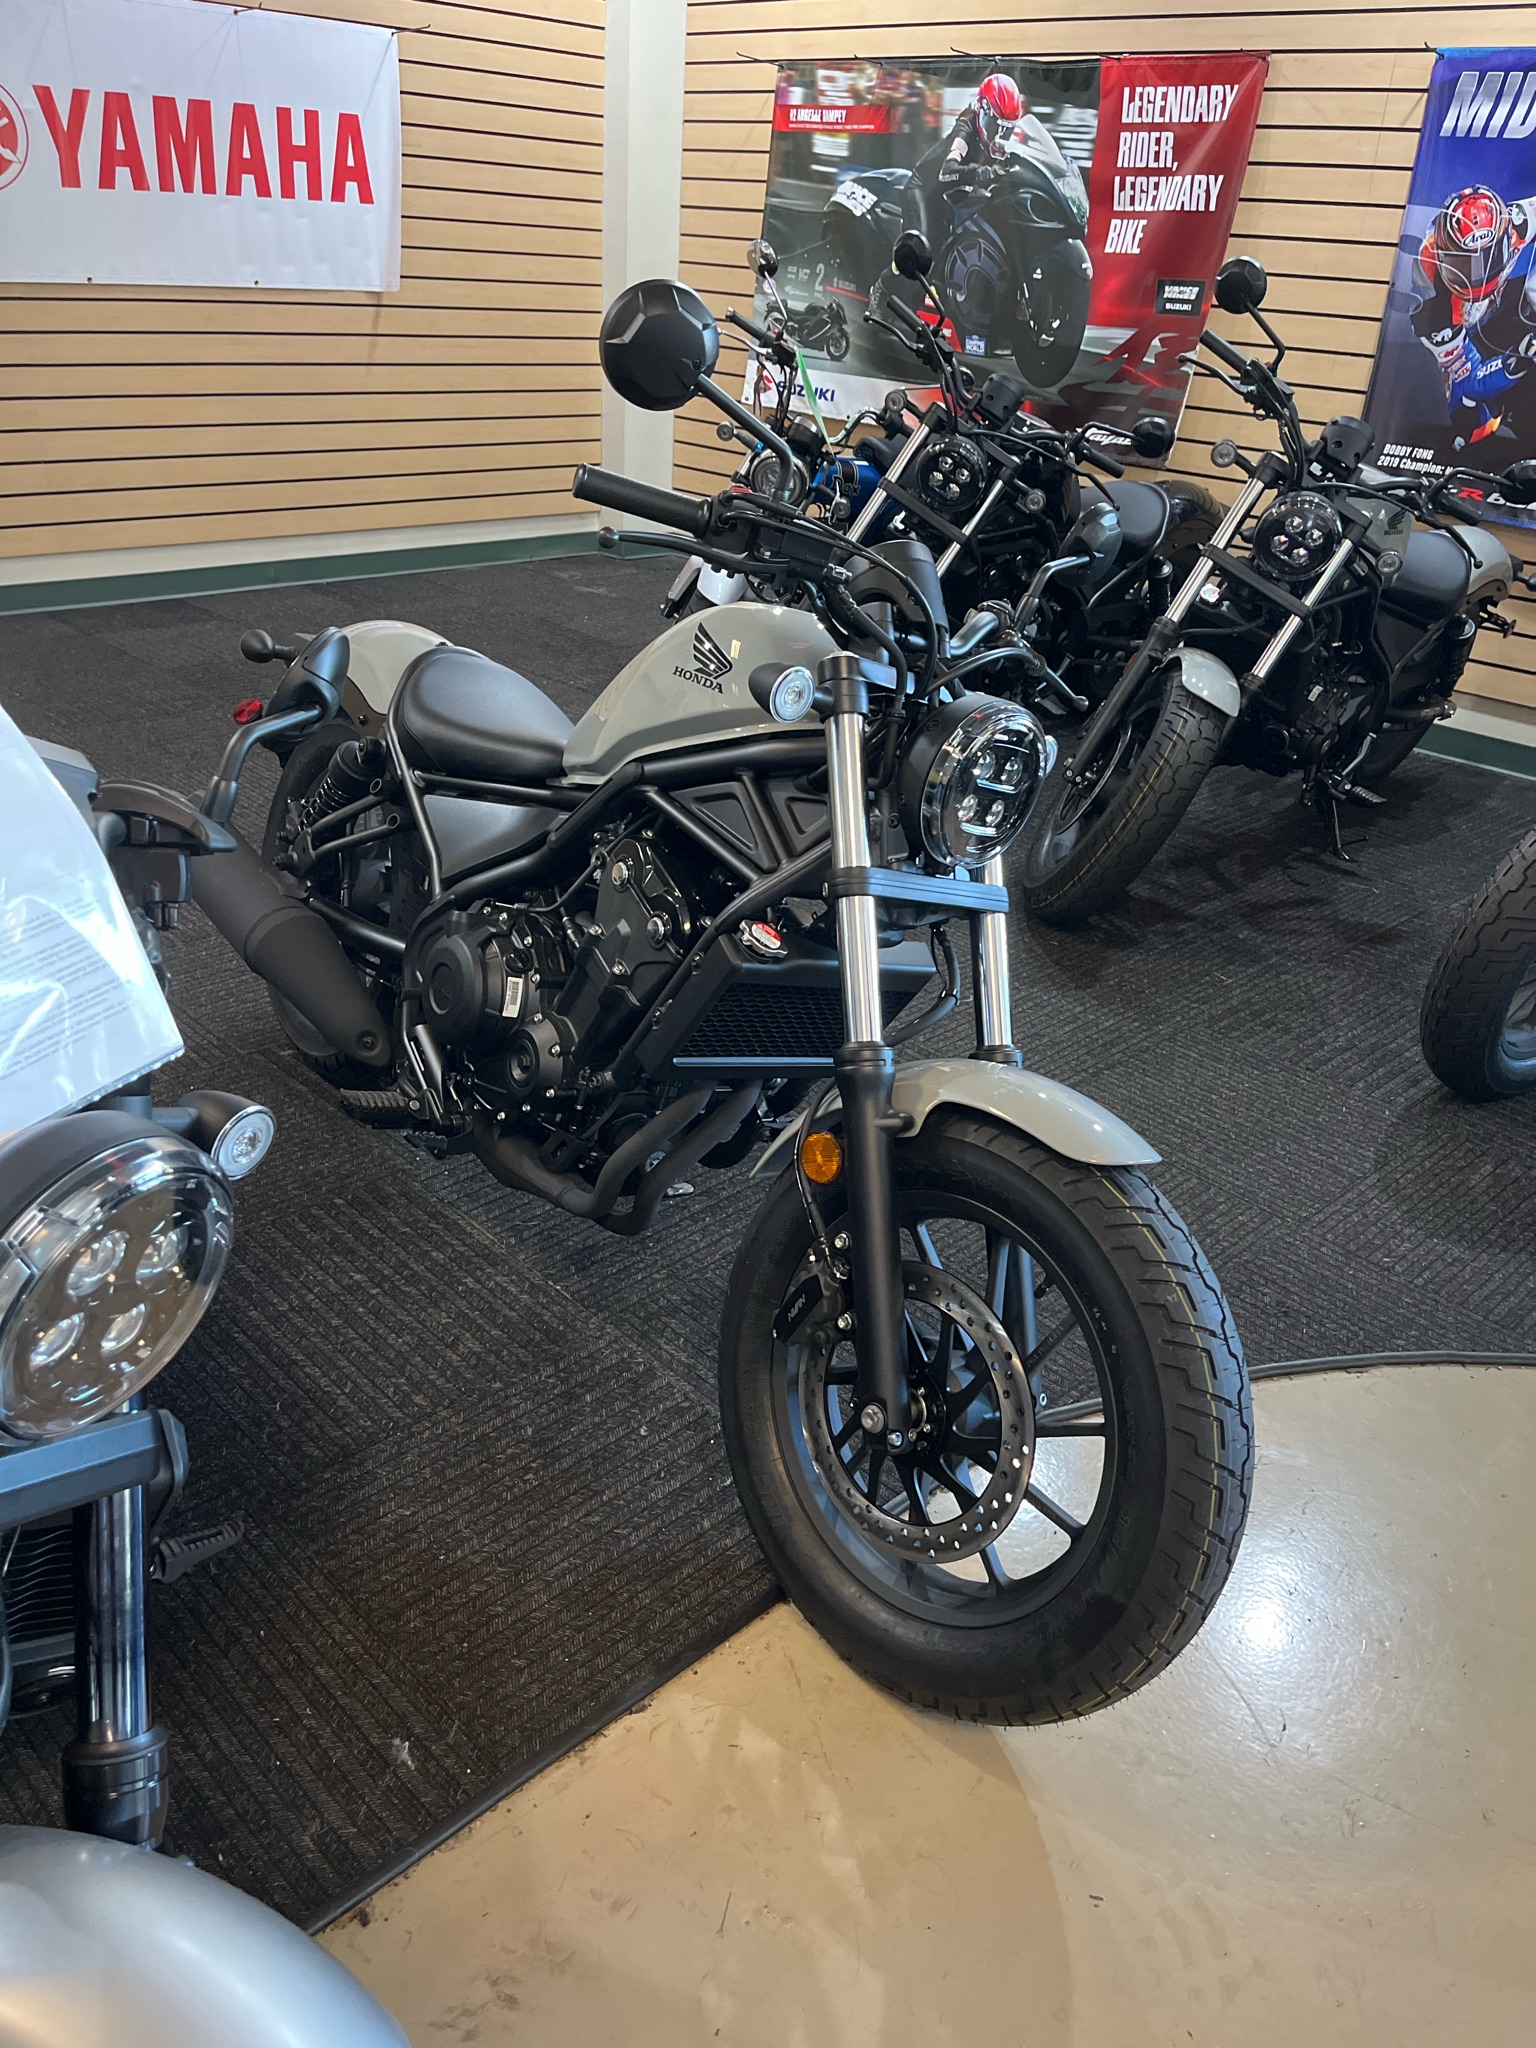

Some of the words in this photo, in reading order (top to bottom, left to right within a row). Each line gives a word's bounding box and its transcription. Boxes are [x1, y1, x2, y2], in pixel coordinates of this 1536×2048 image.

[1121, 84, 1239, 123] LEGENDARY
[32, 84, 375, 205] YAMAHA
[1116, 131, 1179, 172] RIDER,
[1113, 174, 1225, 212] LEGENDARY
[1104, 218, 1148, 254] BIKE
[1468, 230, 1494, 245] Arai
[1165, 302, 1192, 311] SUZUKI
[1377, 455, 1400, 468] 2019
[1399, 458, 1445, 475] Champion:
[1382, 443, 1413, 458] BOBBY
[1412, 448, 1434, 461] FONG
[672, 665, 724, 695] HONDA
